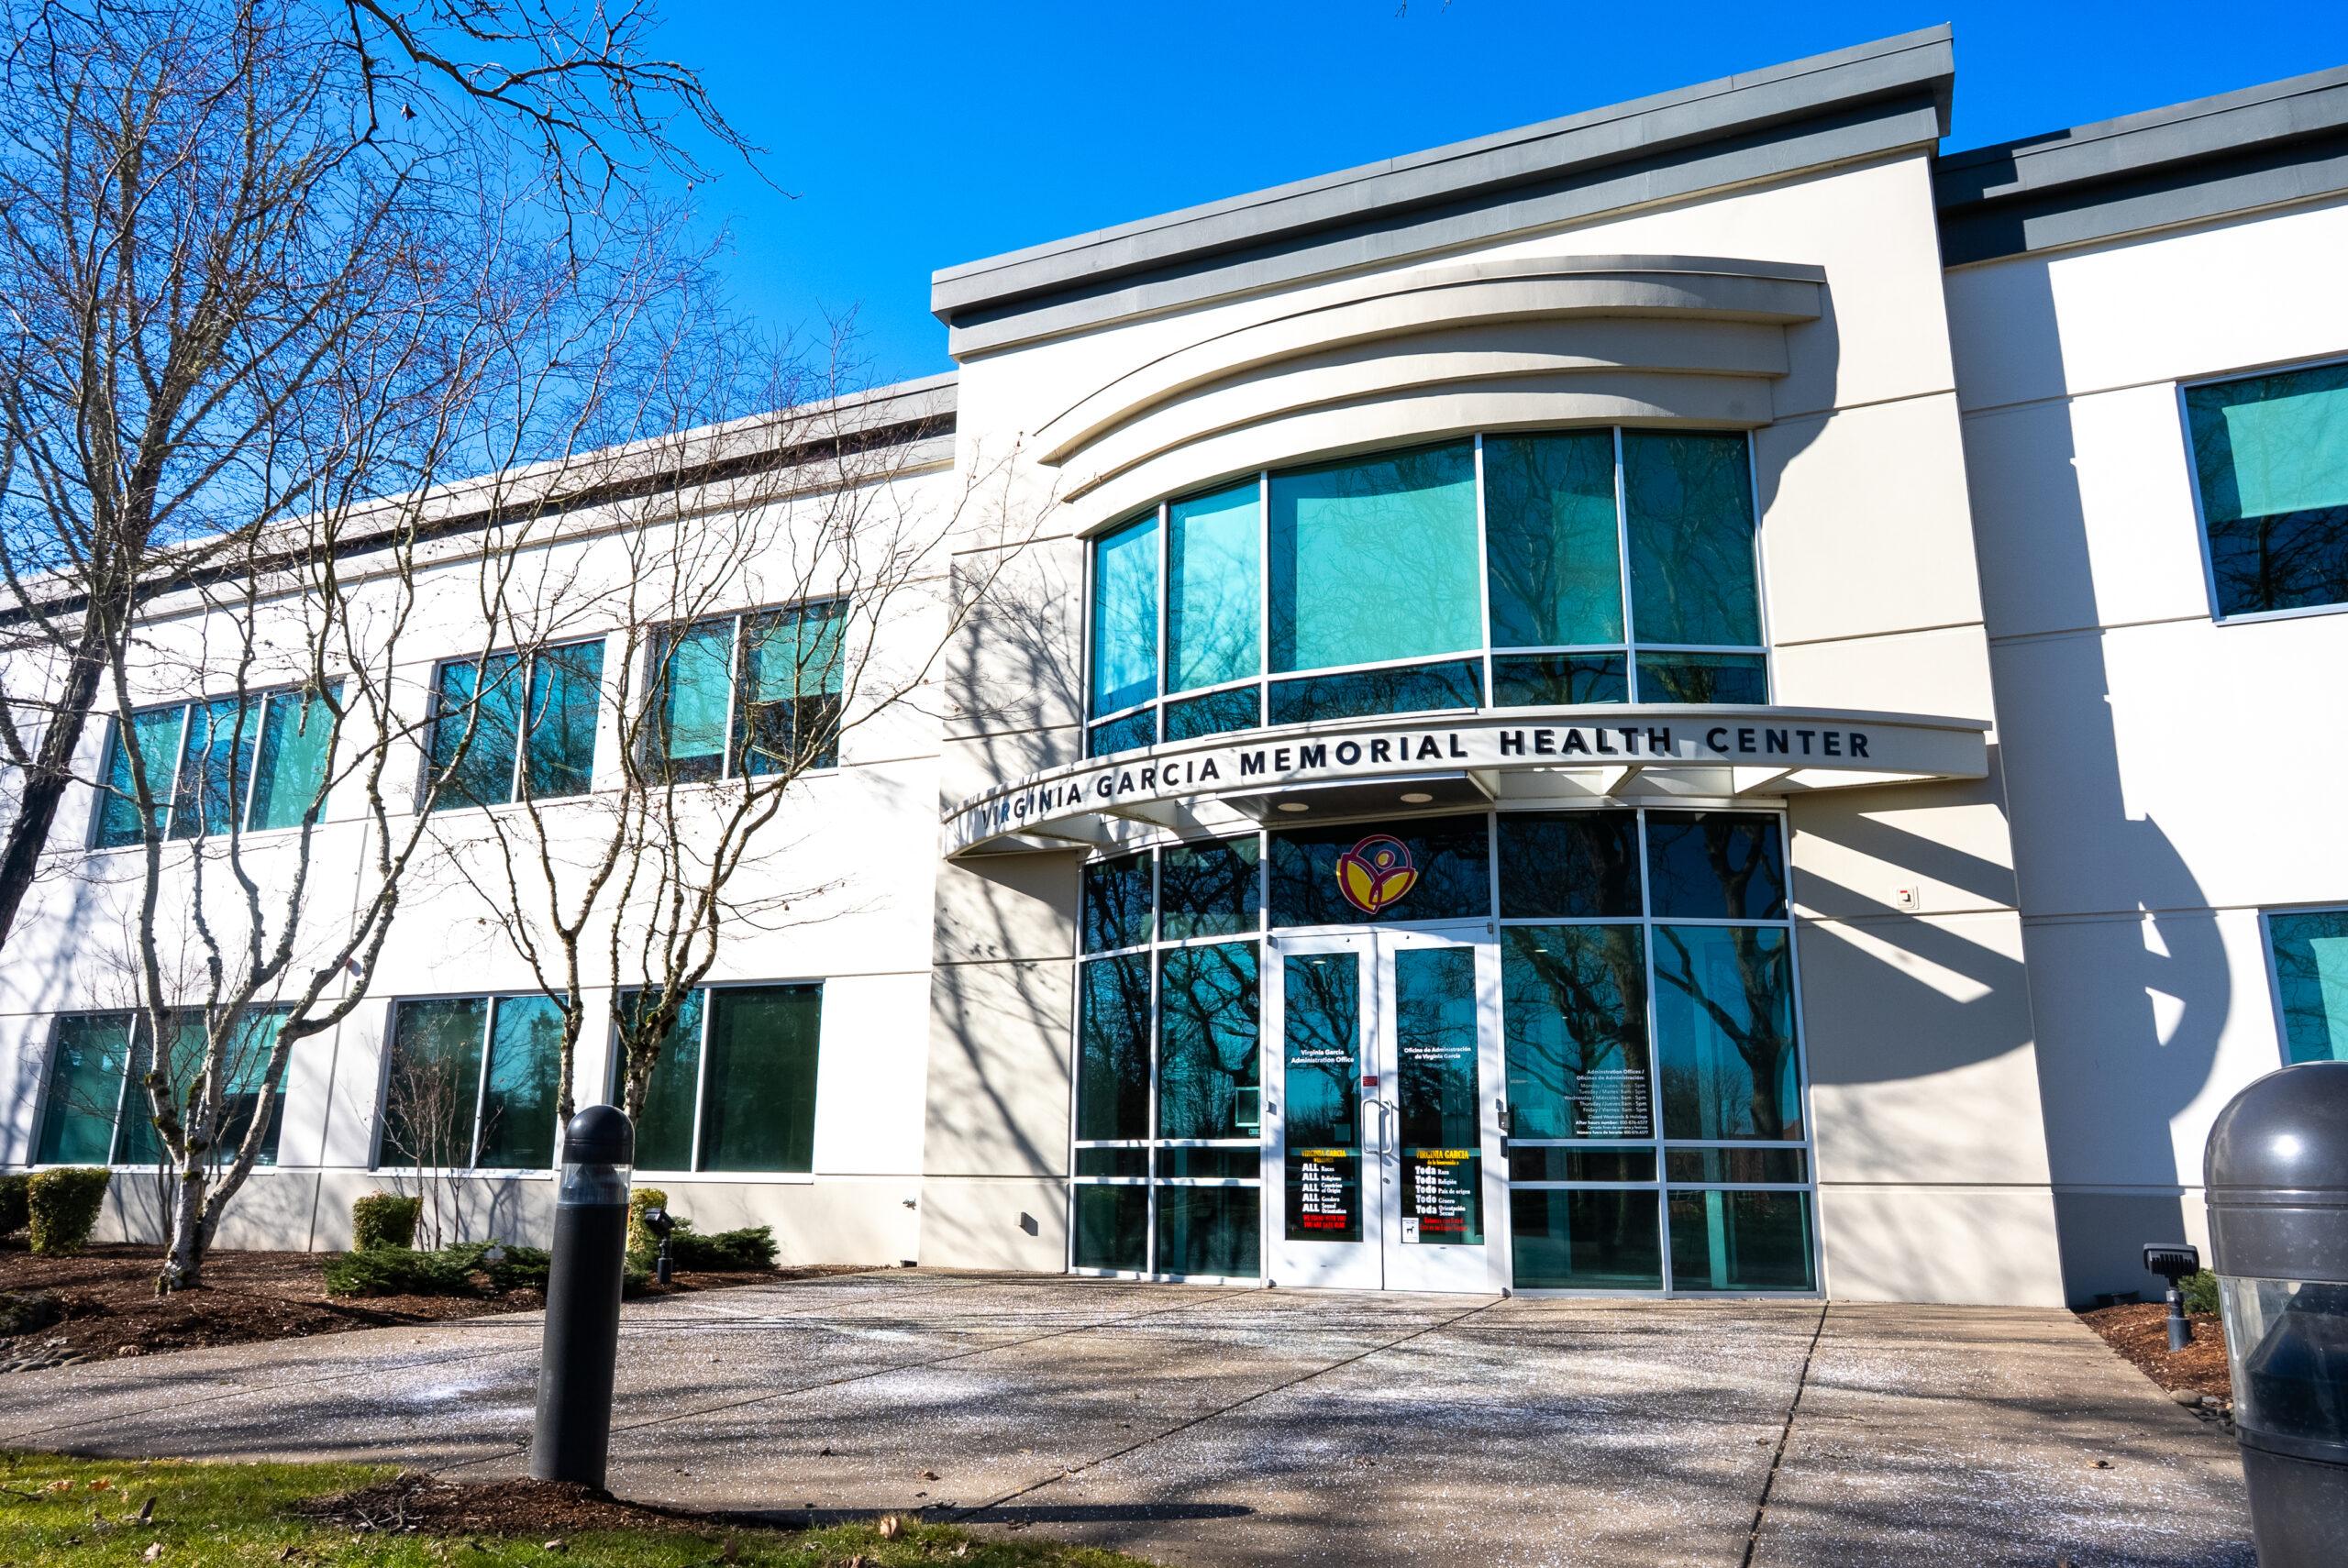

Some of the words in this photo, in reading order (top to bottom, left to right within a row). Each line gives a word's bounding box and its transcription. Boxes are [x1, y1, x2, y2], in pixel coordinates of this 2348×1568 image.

[982, 783, 1081, 830] VIRGINIA
[1097, 758, 1220, 798] GARCIA
[1240, 734, 1468, 776] MEMORIAL
[1501, 727, 1672, 756] HEALTH
[1706, 727, 1869, 757] CENTER
[1445, 1150, 1469, 1159] GARCIA
[1302, 1163, 1319, 1171] ALL
[1415, 1165, 1436, 1175] Toda
[1302, 1173, 1319, 1181] ALL
[1415, 1176, 1436, 1184] Toda
[1302, 1183, 1319, 1191] ALL
[1415, 1185, 1436, 1194] Todo
[1302, 1193, 1319, 1201] ALL
[1415, 1195, 1436, 1203] Todo
[1302, 1203, 1319, 1211] ALL
[1415, 1205, 1436, 1213] Toda
